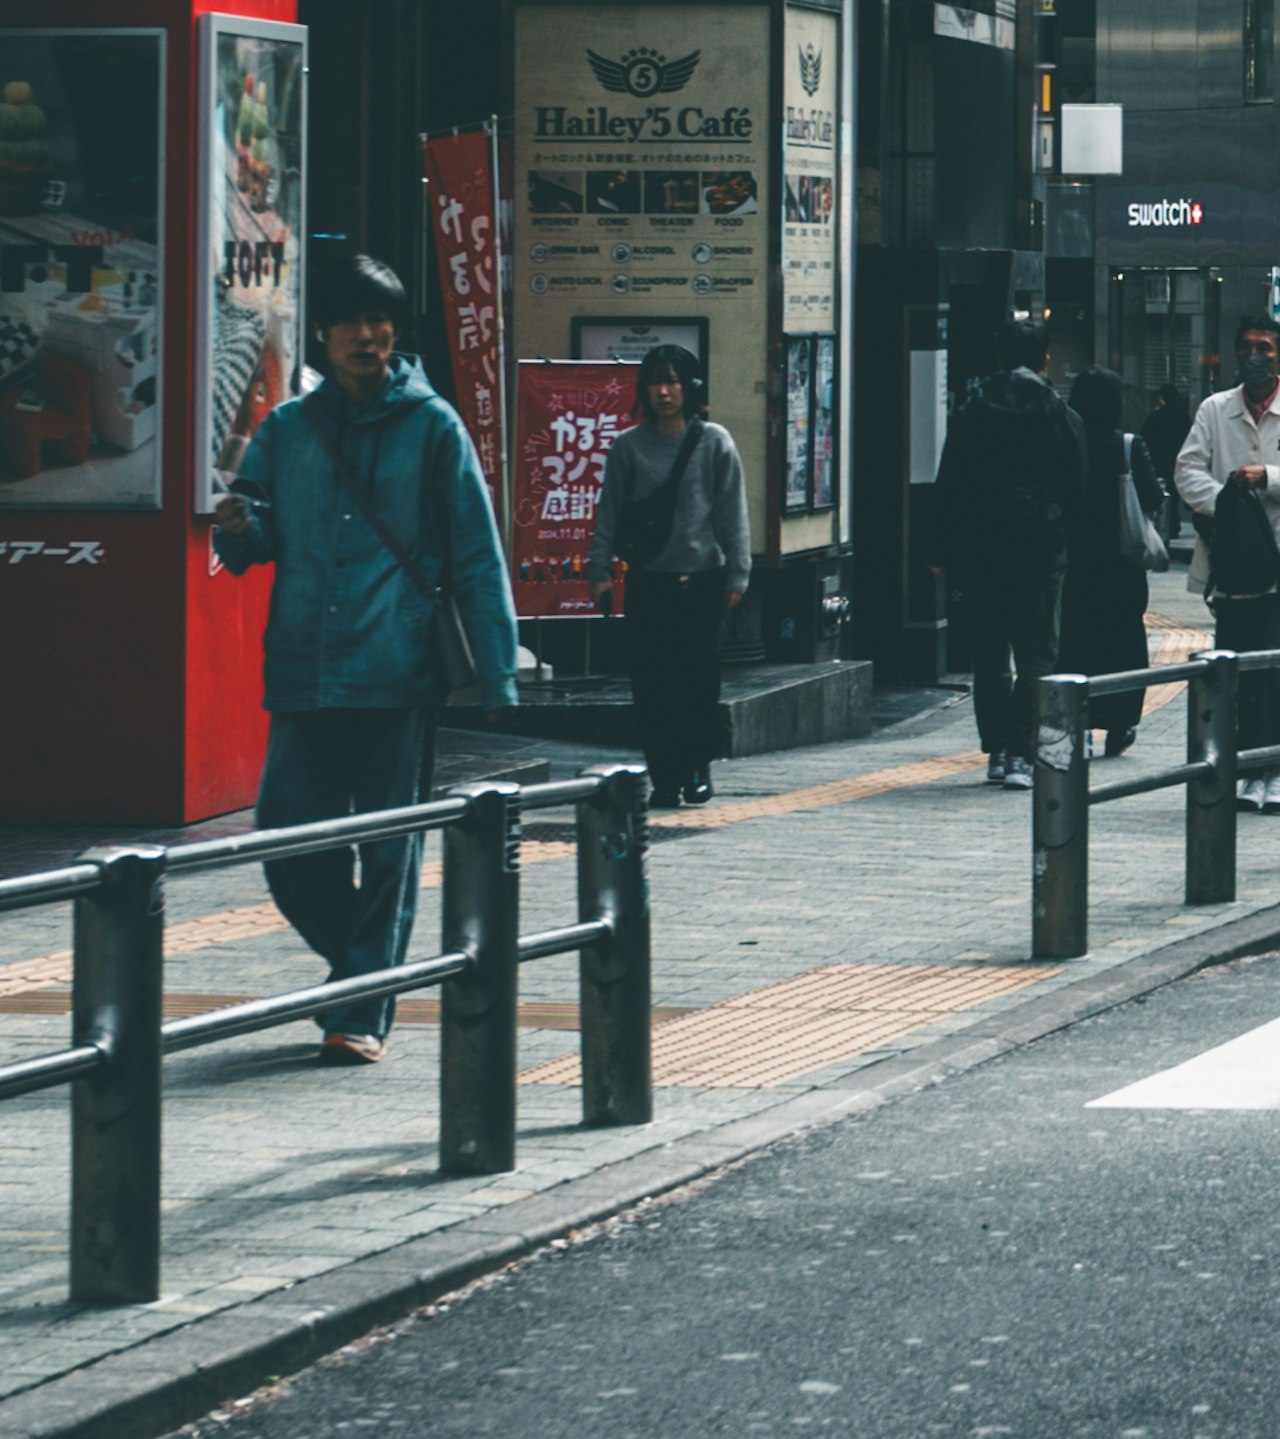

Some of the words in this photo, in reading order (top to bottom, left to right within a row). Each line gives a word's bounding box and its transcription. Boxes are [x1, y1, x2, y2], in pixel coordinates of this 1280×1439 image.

[678, 106, 753, 138] Café
[715, 217, 744, 226] FOOD
[1127, 198, 1192, 227] swatch
[632, 246, 676, 255] ALCOHOL
[550, 411, 620, 452] やる気
[541, 483, 603, 521] 感謝
[0, 540, 104, 565] アーズ
